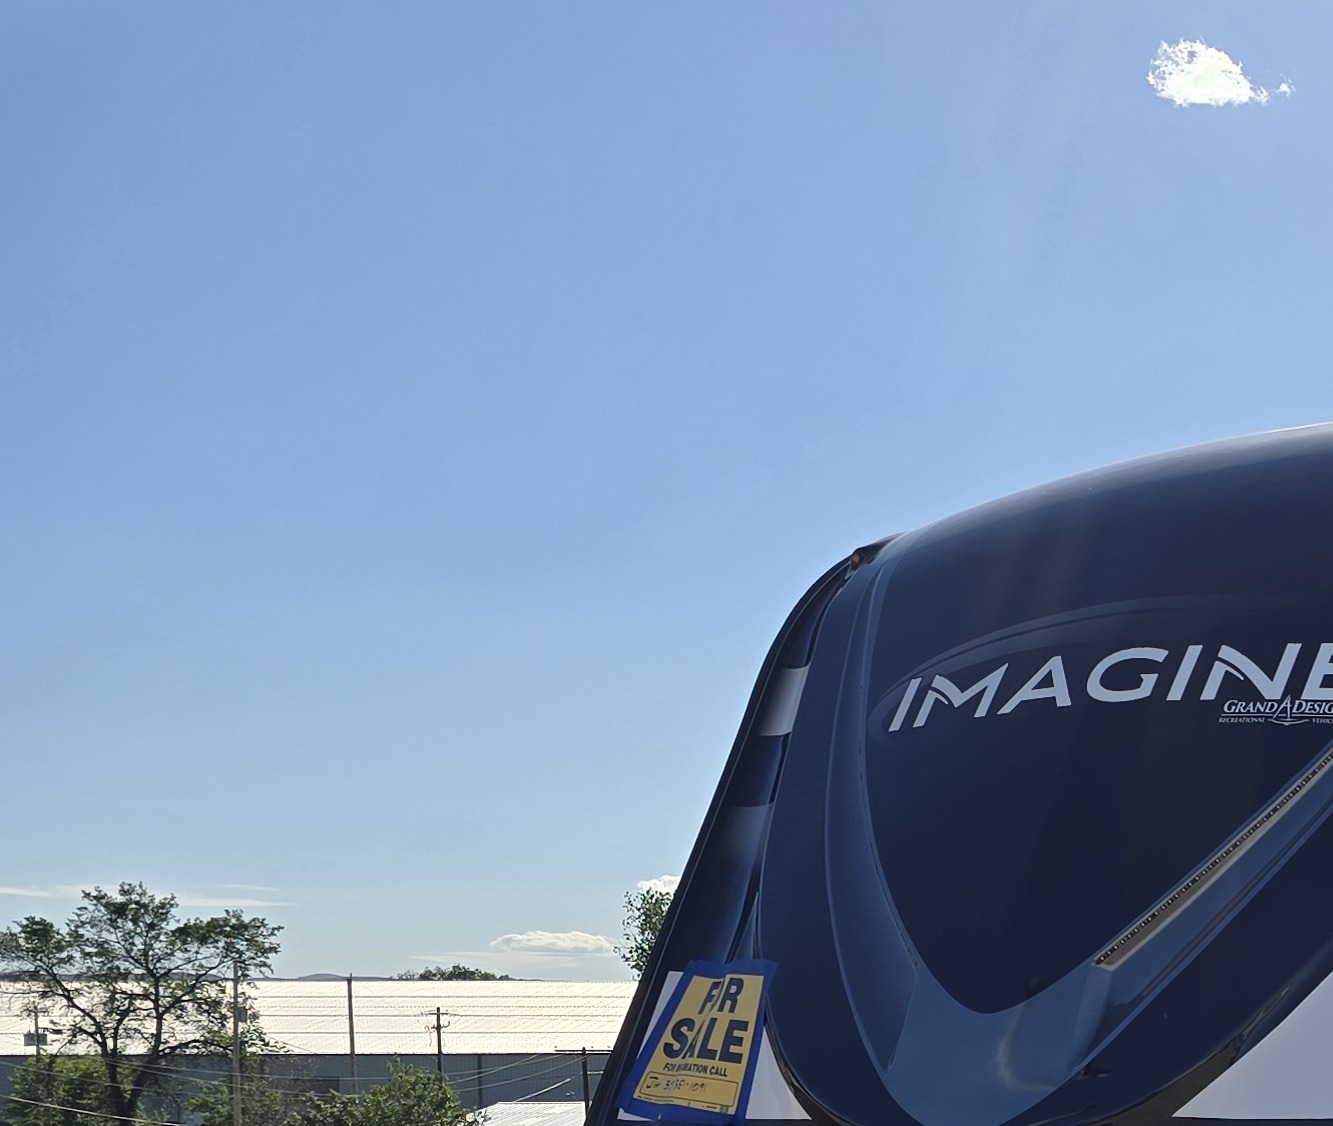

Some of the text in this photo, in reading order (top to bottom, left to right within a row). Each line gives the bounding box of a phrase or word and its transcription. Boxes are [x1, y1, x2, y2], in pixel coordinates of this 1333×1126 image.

[1223, 699, 1278, 713] GRAND
[663, 1017, 750, 1065] SALE
[709, 1066, 728, 1078] CALL
